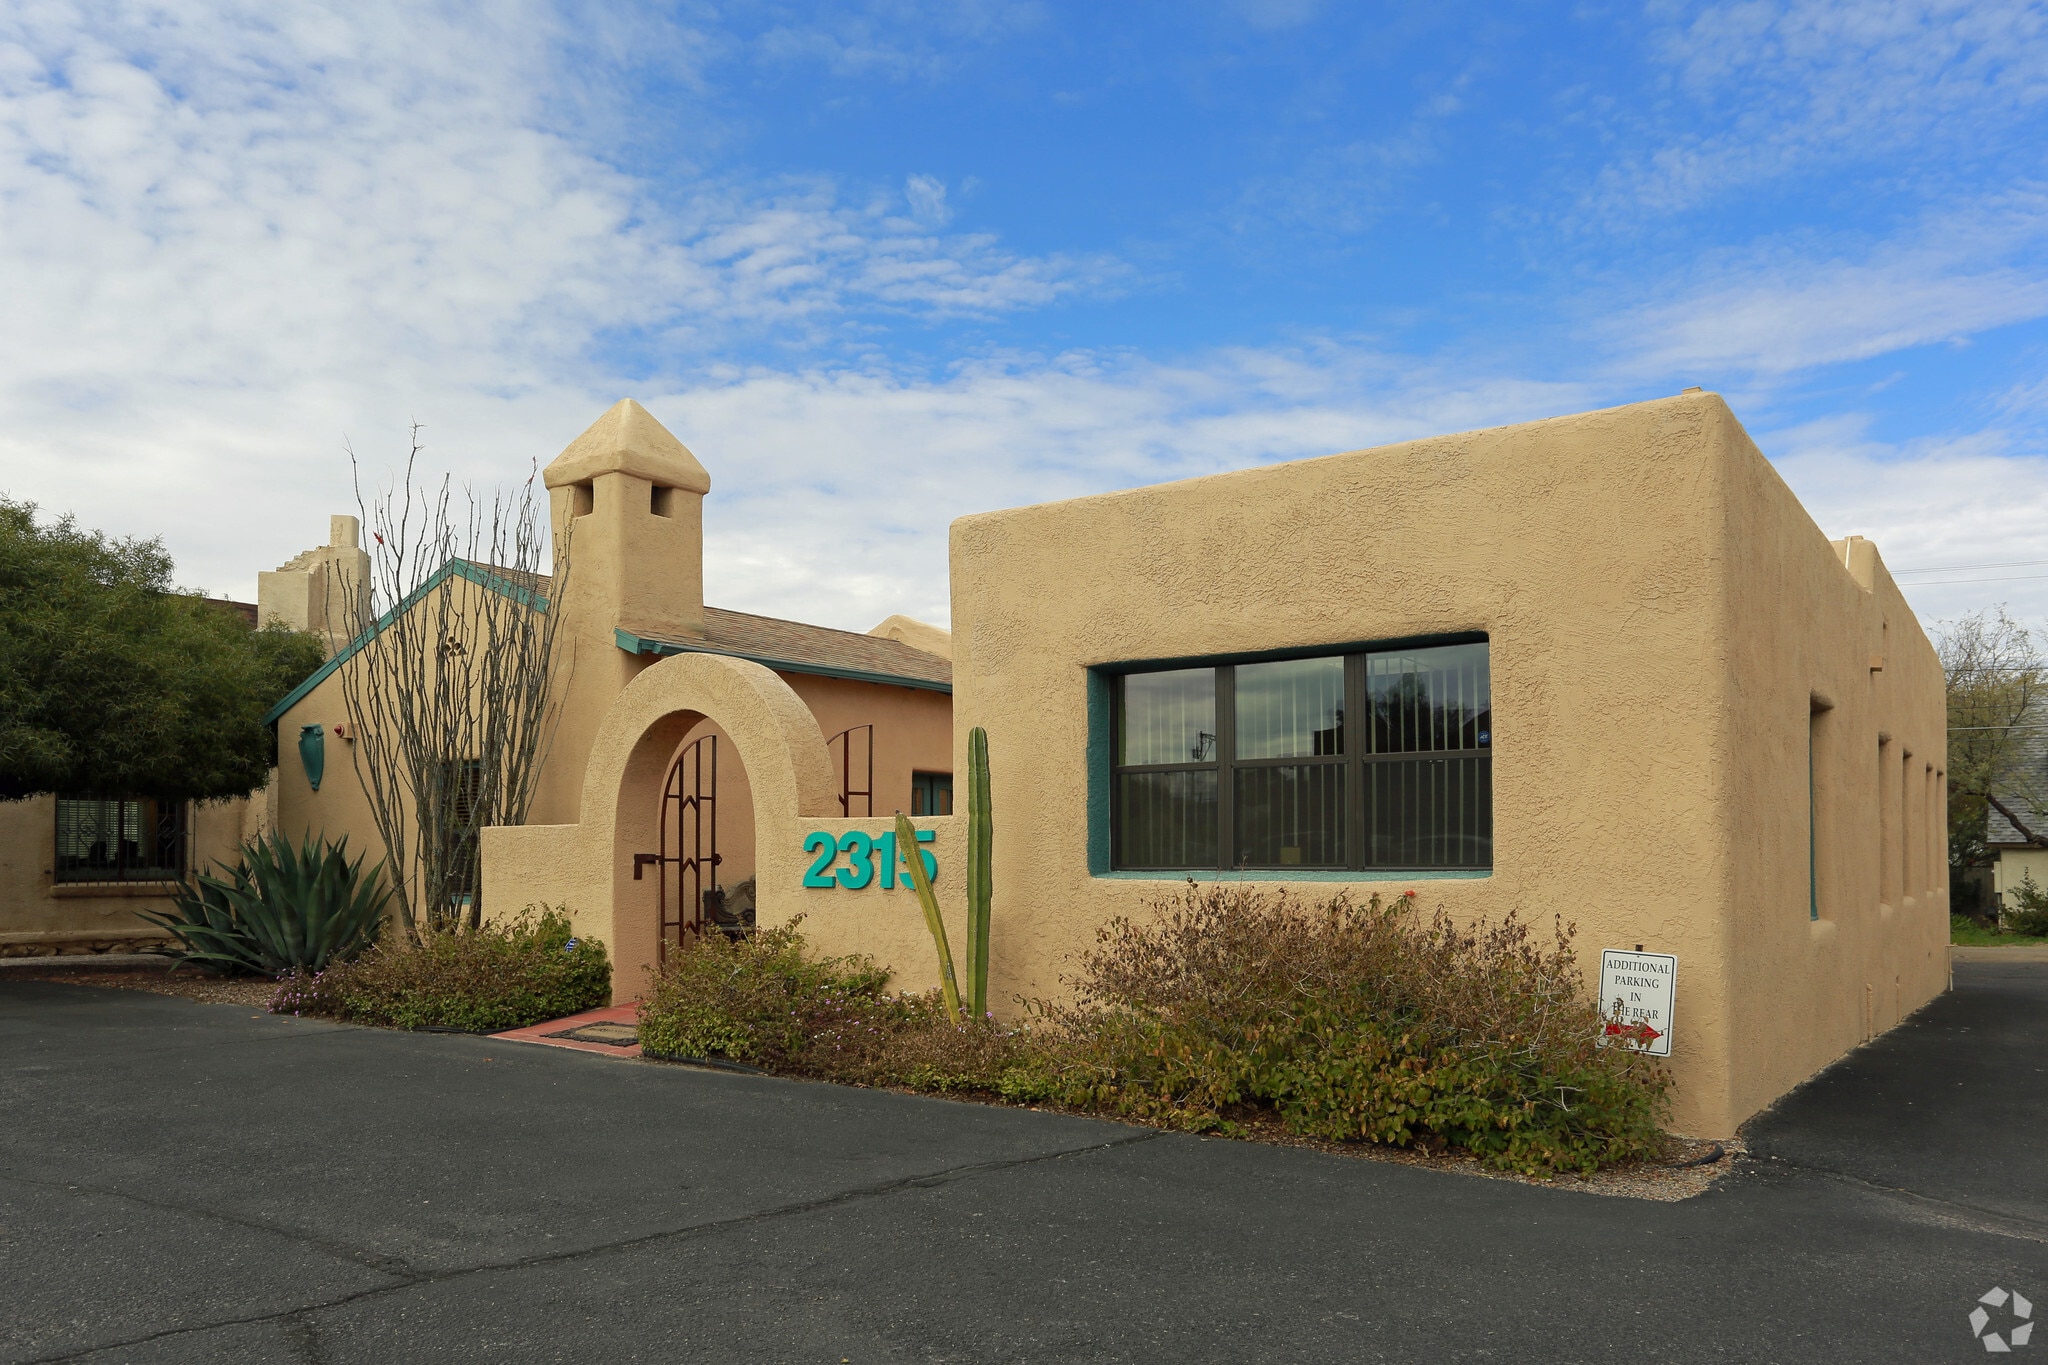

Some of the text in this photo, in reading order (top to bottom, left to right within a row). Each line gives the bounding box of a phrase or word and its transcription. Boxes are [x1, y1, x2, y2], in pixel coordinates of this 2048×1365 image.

[803, 829, 938, 890] 2315
[1606, 959, 1670, 974] ADDITIONAL
[1615, 975, 1659, 988] PARKING
[1630, 992, 1642, 1002] IN
[1633, 1007, 1659, 1019] REAR
